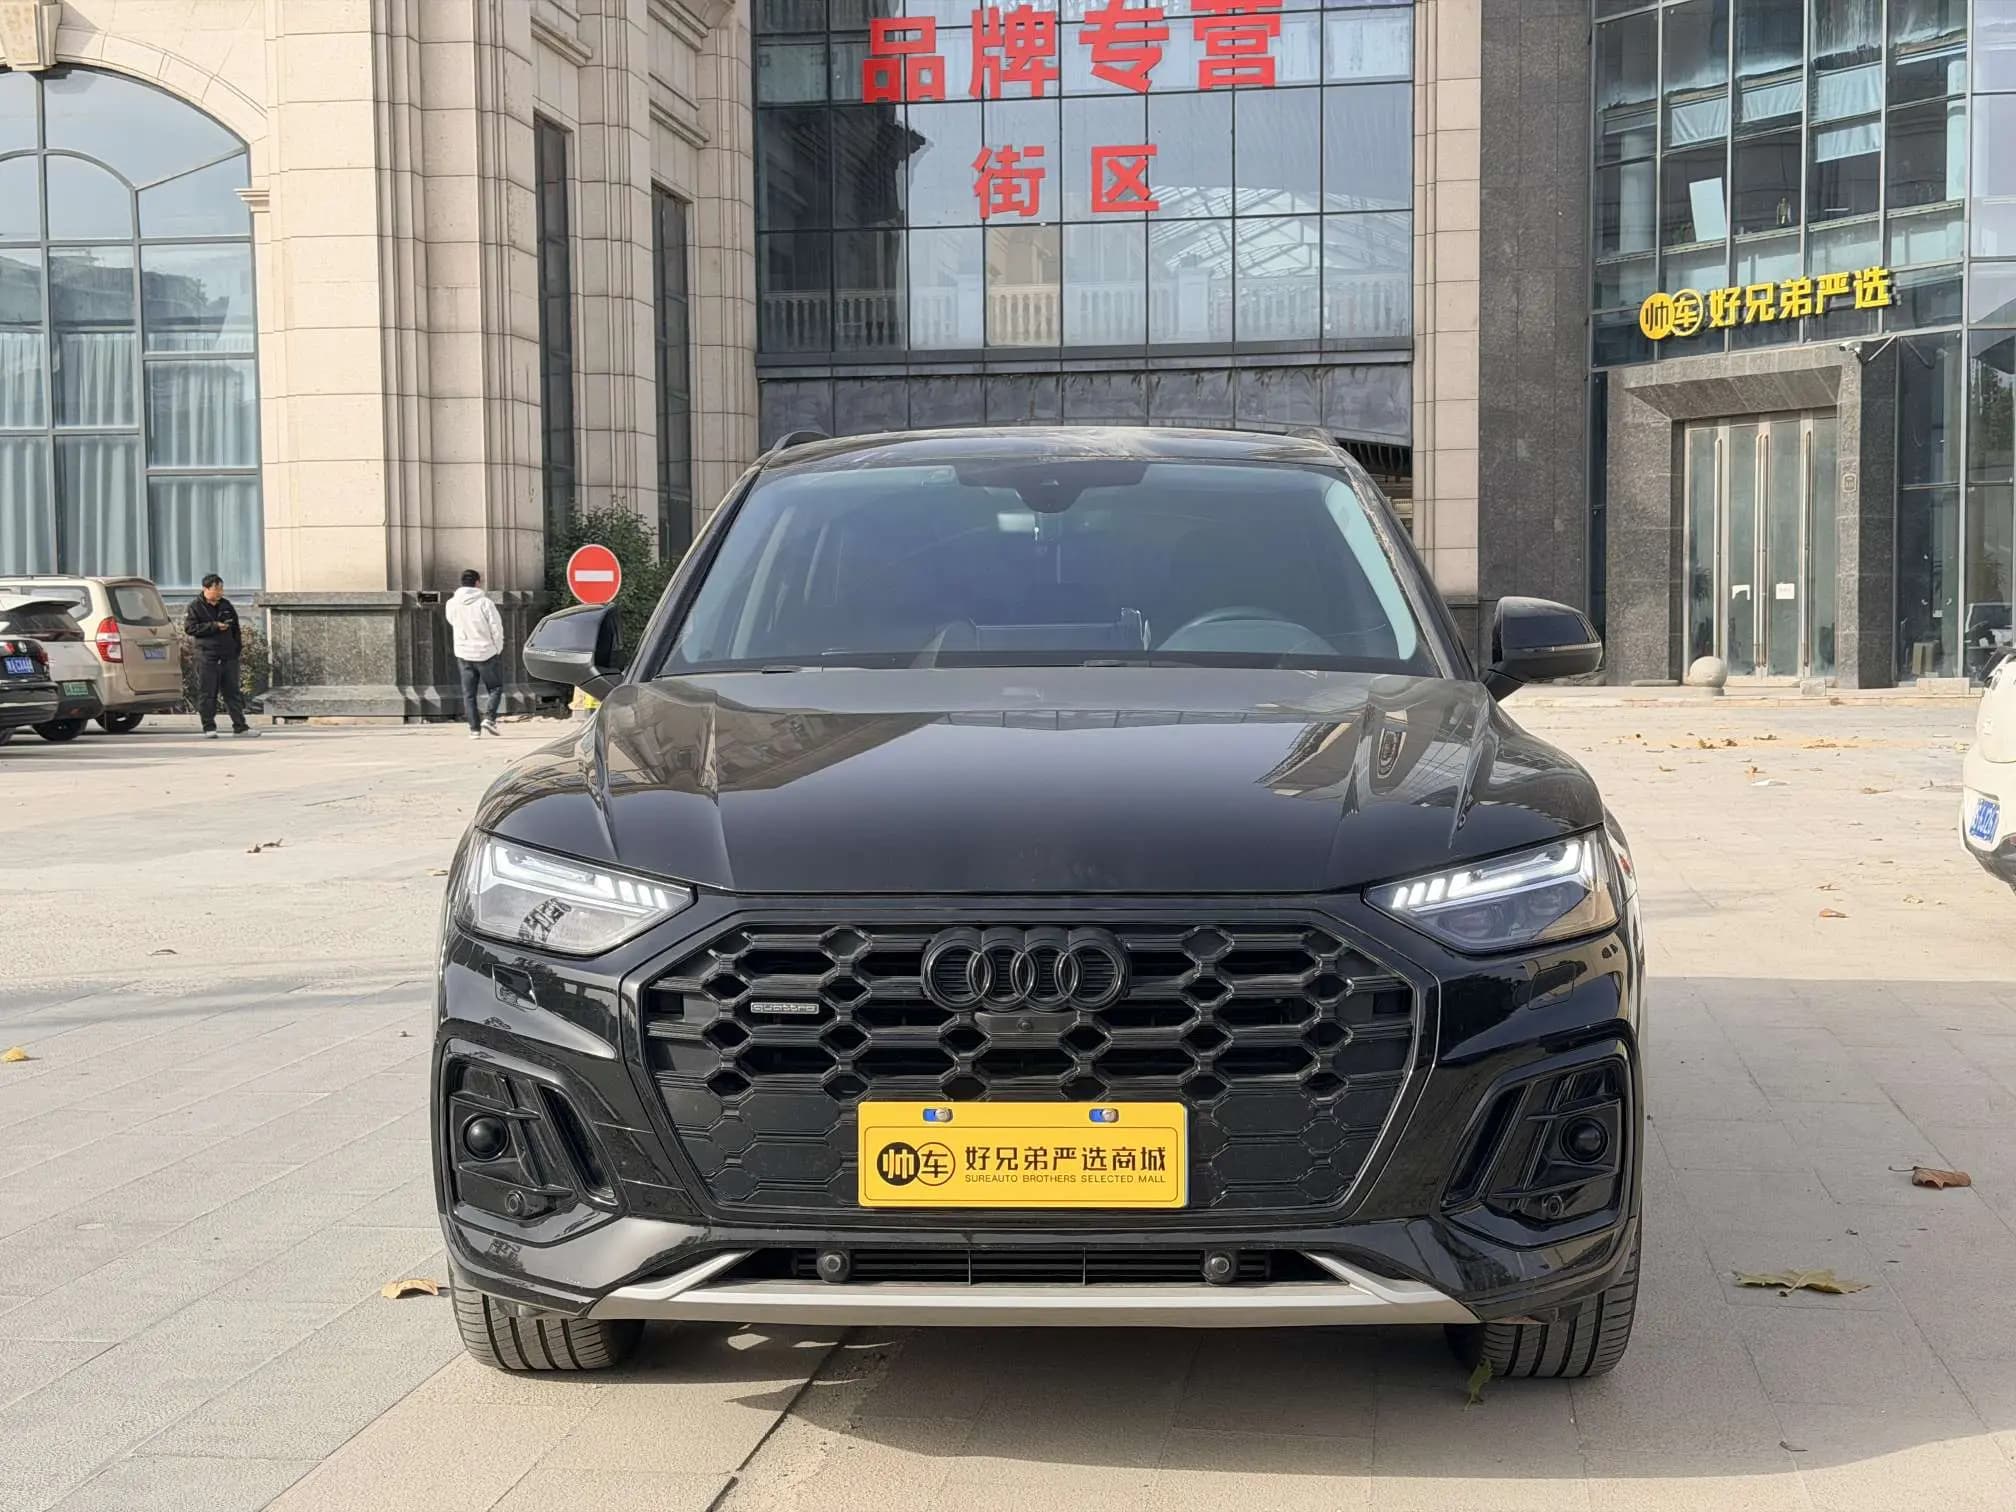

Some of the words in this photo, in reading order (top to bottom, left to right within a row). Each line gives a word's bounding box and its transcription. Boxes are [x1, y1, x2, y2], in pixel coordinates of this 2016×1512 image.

[863, 0, 1283, 103] 品牌专营
[971, 144, 1160, 219] 街区
[1708, 265, 1891, 328] 好兄弟严选
[880, 1146, 952, 1182] 帅车
[965, 1146, 1167, 1171] 好兄弟严选商城
[965, 1174, 1018, 1183] SUREAUTO
[1022, 1174, 1077, 1183] BROTHERS
[1081, 1174, 1134, 1183] SELECTED
[1138, 1174, 1166, 1183] MALL
